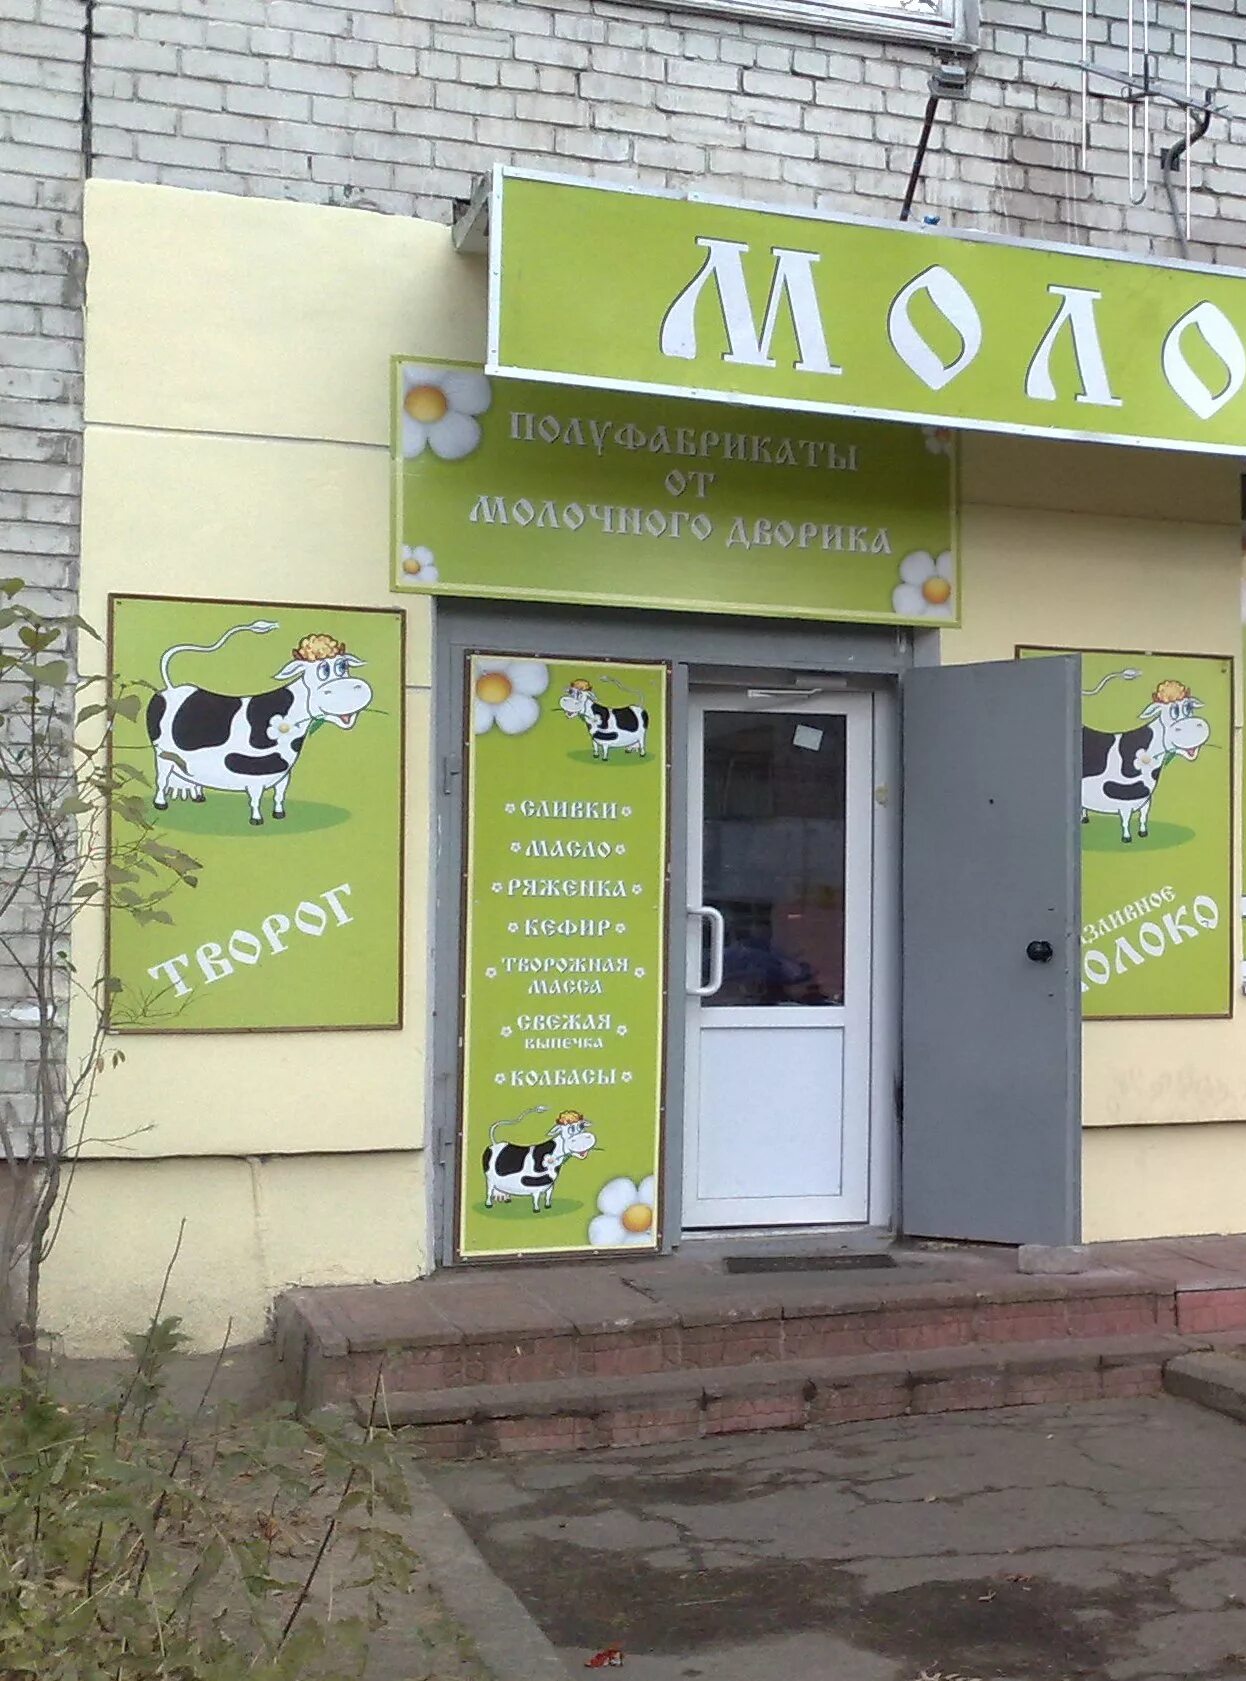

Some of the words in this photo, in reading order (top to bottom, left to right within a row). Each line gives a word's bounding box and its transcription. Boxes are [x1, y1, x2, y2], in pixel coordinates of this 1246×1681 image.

[508, 410, 860, 472] ПОЛУФАБРИКАТЫ
[664, 468, 717, 499] ОТ
[468, 495, 714, 541] МОЛОЧНОГО
[725, 516, 893, 556] ДВОРИКА
[519, 799, 619, 820] СЛИВКИ
[524, 839, 613, 860] МАСЛО
[506, 878, 629, 898] РЯЖЕНКА
[1081, 885, 1177, 945] ЗЛИВНОЕ
[523, 918, 612, 938] КЕФИР
[147, 883, 354, 999] ТВОРОГ
[1081, 895, 1219, 993] ОЛОКО
[501, 956, 630, 974] ТВОРОЖНАЯ
[527, 979, 604, 995] МАССА
[516, 1013, 612, 1032] СВЕЖАЯ
[523, 1037, 605, 1050] ВЫПЕЧКА
[509, 1067, 618, 1088] КОЛБАСЫ
